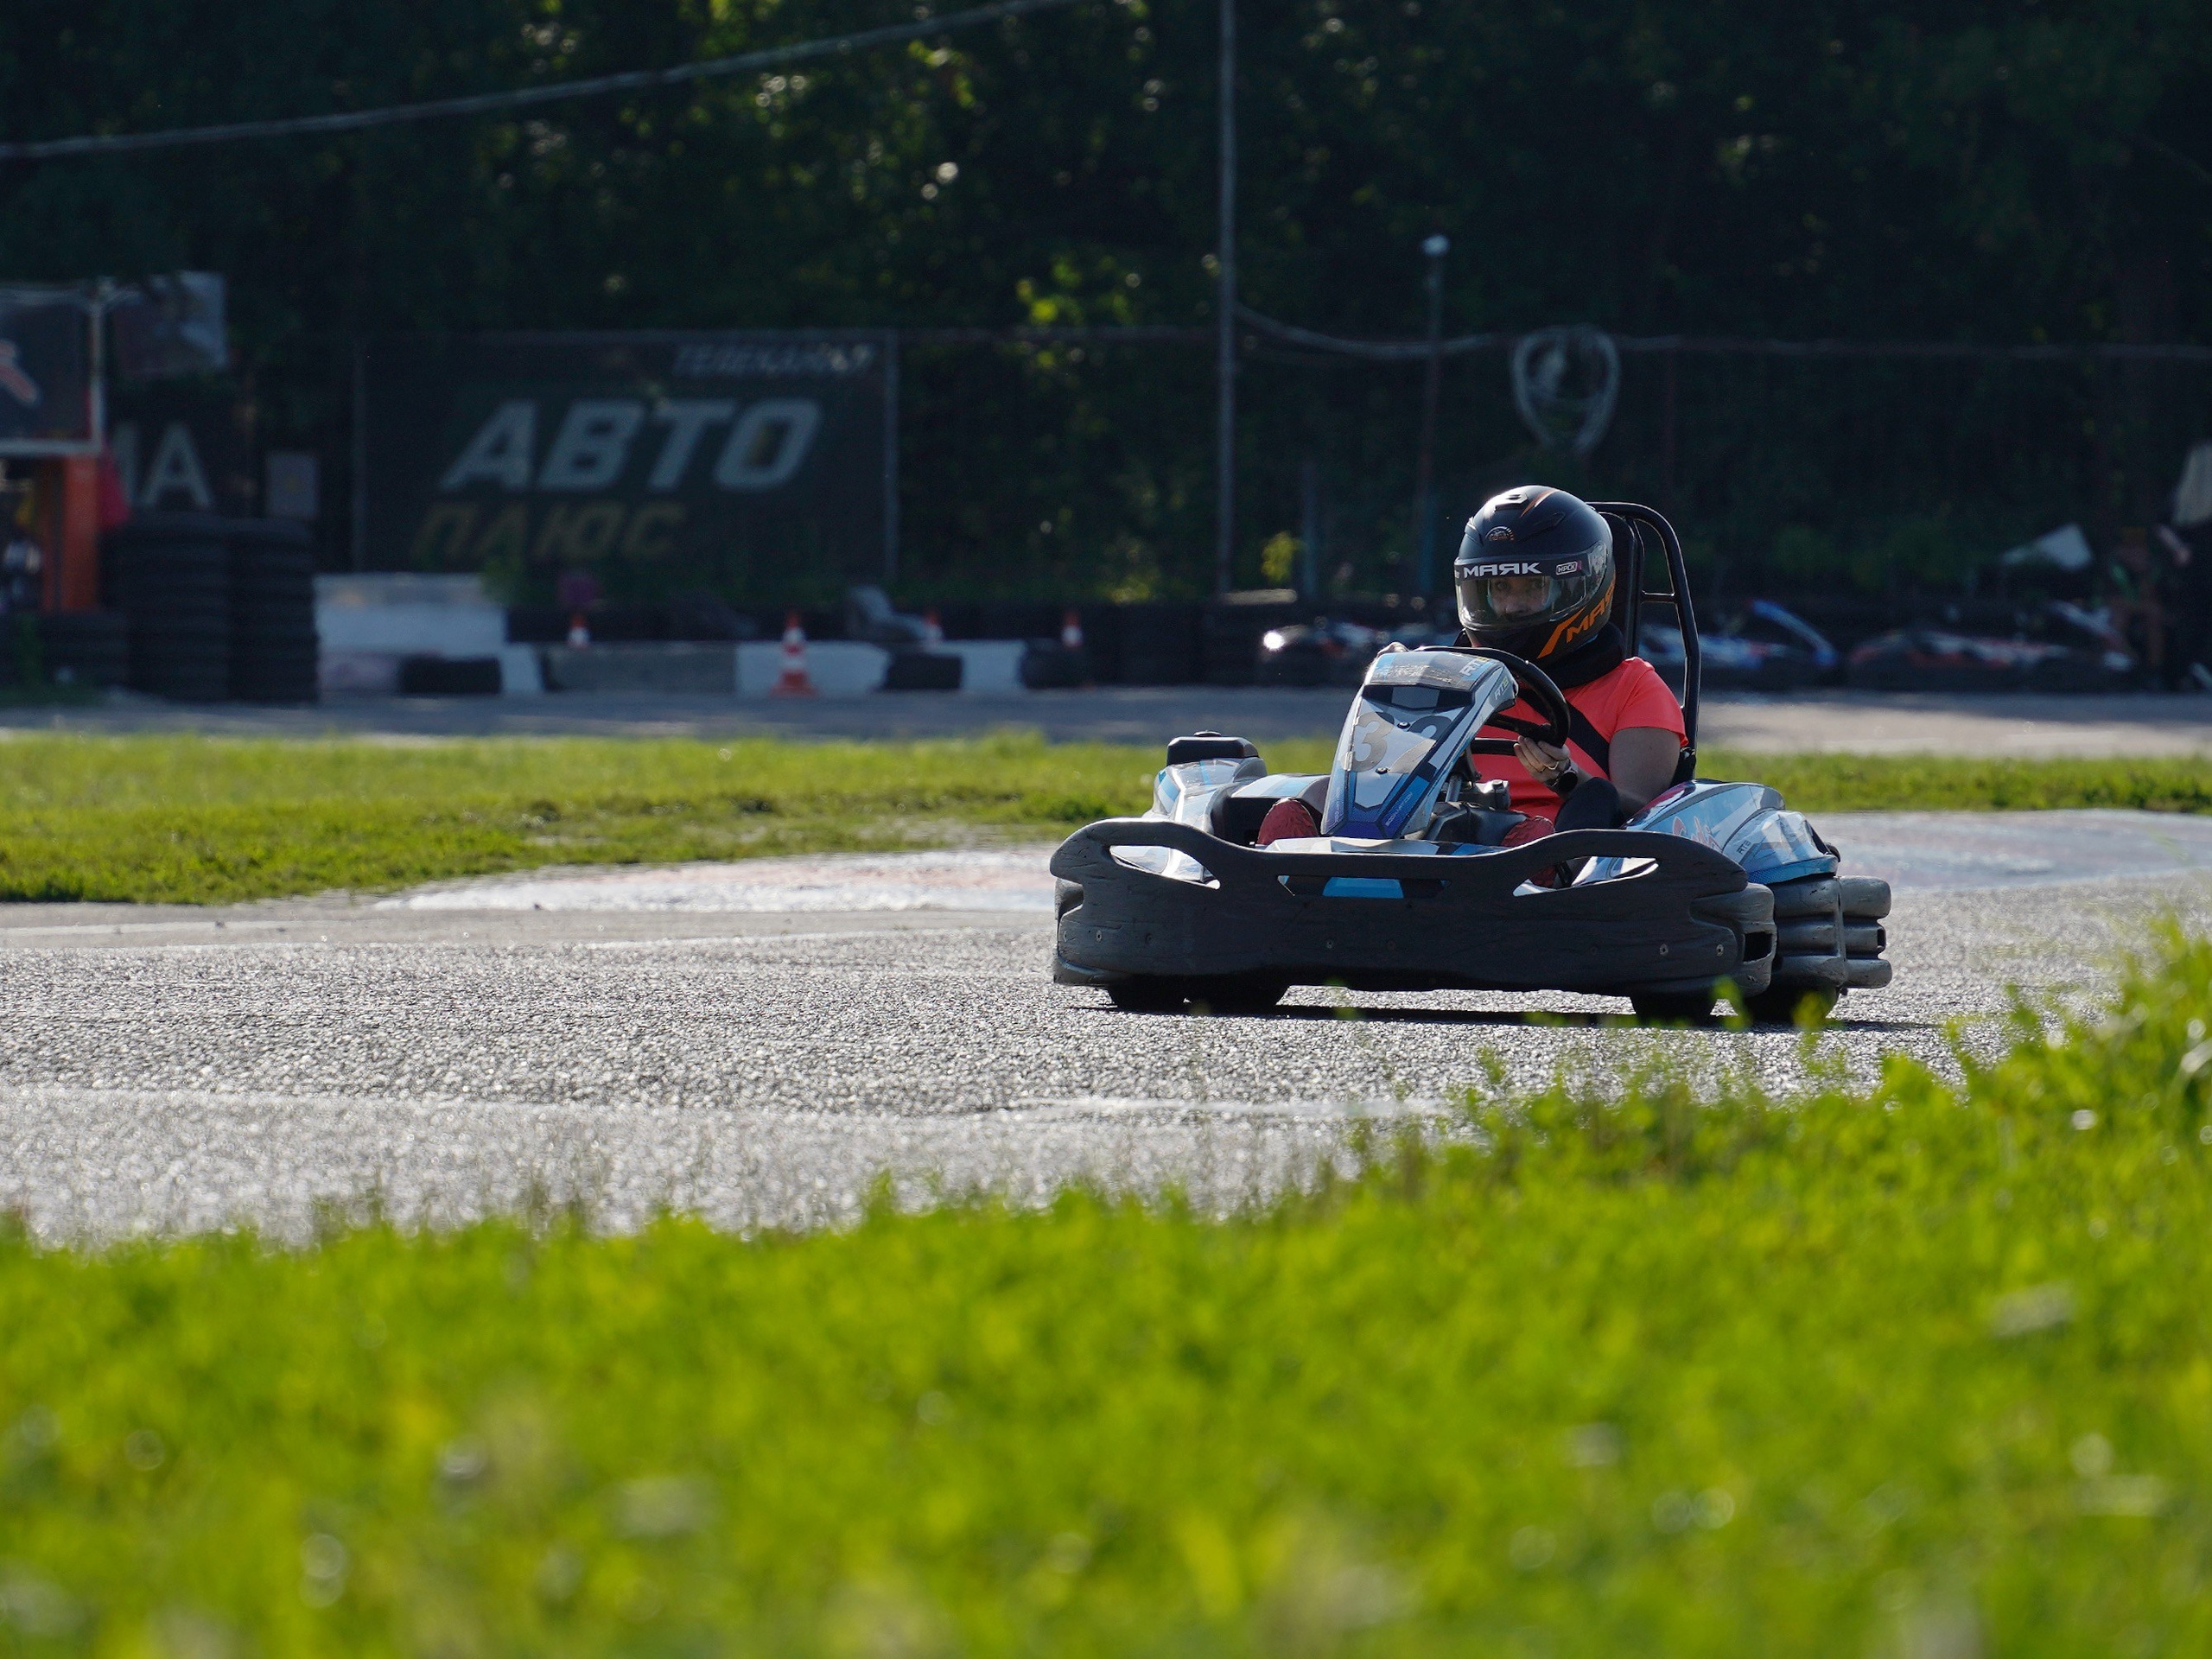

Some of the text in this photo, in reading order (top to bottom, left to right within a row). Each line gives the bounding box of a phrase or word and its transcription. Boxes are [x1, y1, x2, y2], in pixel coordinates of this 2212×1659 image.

[440, 396, 822, 493] АВТО
[411, 501, 689, 561] ПЛЮС
[1463, 562, 1542, 578] МАЯК
[1341, 711, 1453, 774] 32
